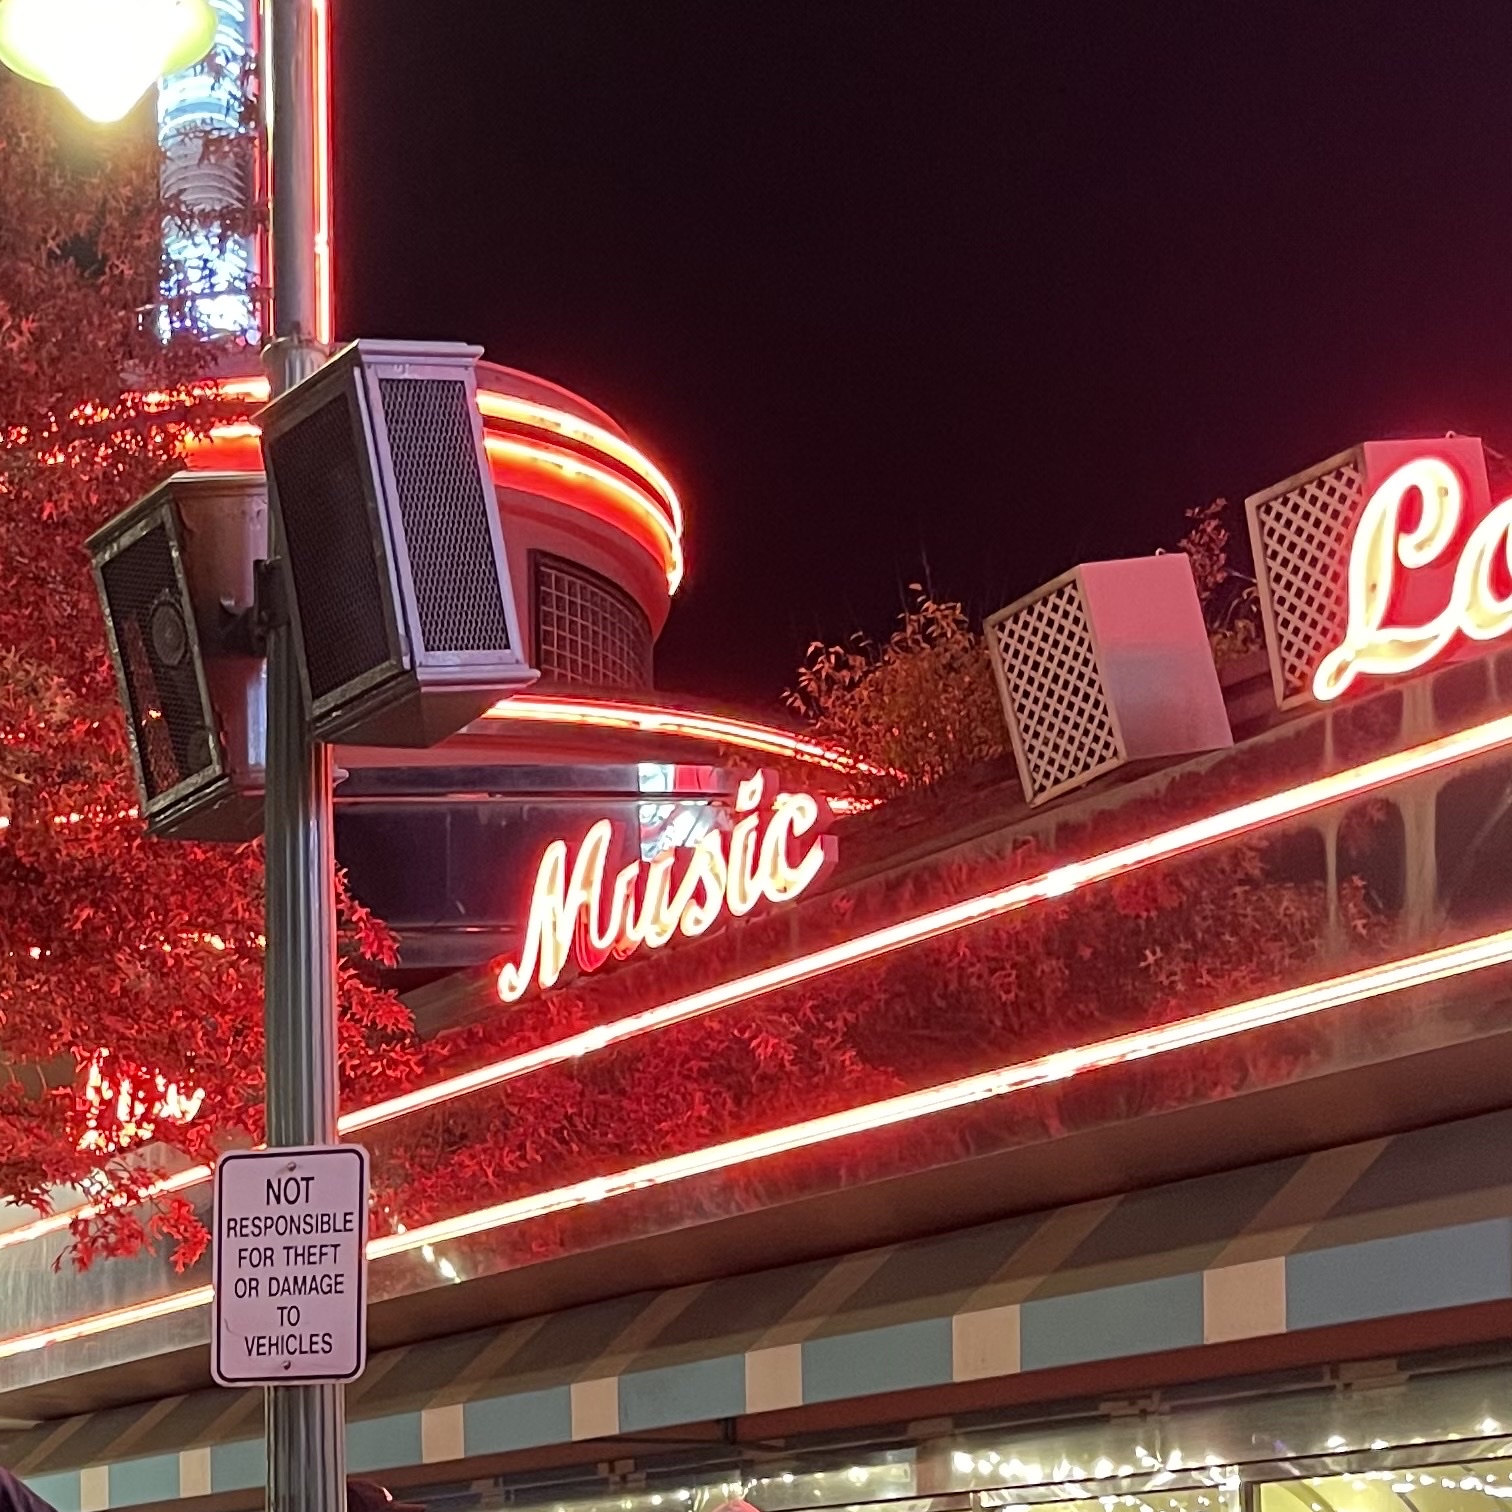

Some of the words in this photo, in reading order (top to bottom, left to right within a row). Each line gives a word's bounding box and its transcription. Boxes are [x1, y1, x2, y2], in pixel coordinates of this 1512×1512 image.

[496, 769, 828, 1003] Music
[266, 1176, 315, 1206] NOT
[226, 1212, 355, 1239] RESPONSIBLE
[238, 1247, 275, 1269] FOR
[283, 1243, 341, 1267] THEFT
[234, 1277, 260, 1299] OR
[268, 1273, 345, 1298] DAMAGE
[276, 1305, 301, 1327] TO
[244, 1333, 333, 1357] VEHICLES
